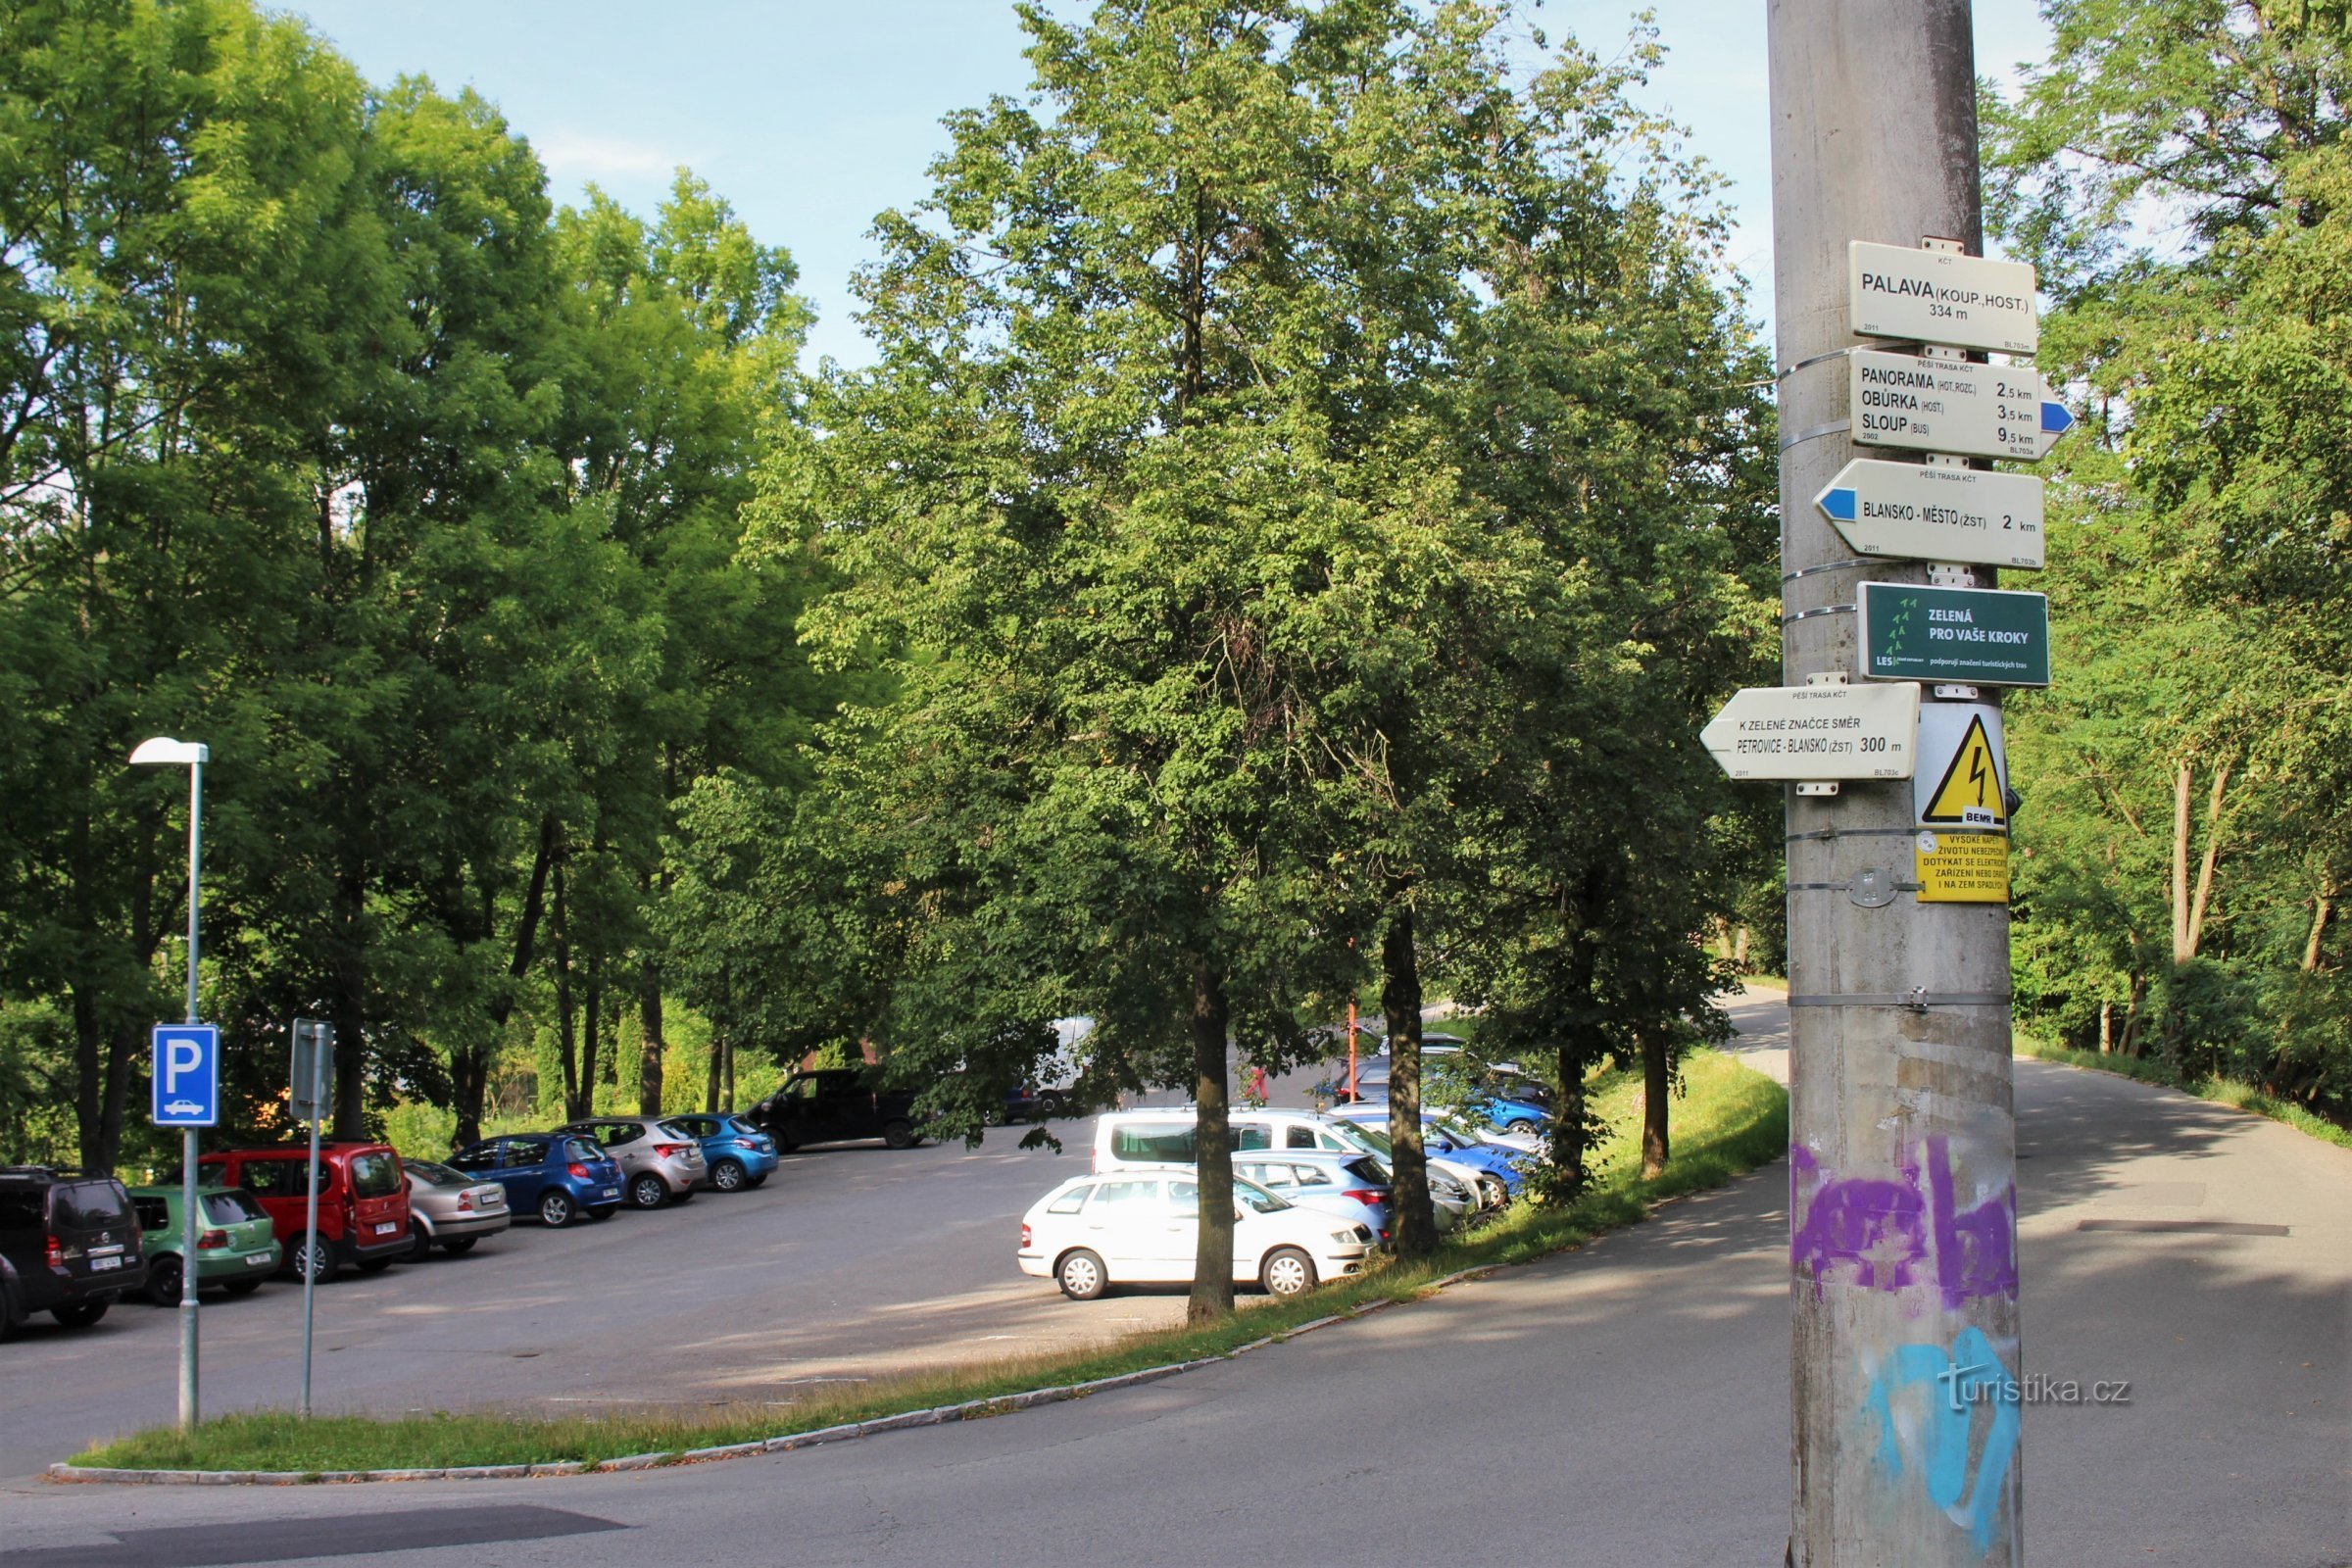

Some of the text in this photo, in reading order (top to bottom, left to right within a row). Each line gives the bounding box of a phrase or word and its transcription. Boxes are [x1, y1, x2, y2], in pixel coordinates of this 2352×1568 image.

[1862, 272, 1935, 299] PALAVA
[1929, 303, 1968, 320] 334 m
[1863, 323, 1879, 332] 2011
[1935, 362, 1958, 371] TRASA
[1959, 365, 1974, 373] KČT
[1862, 368, 1935, 390] PANORAMA
[1996, 382, 2015, 400] 2,5
[2017, 389, 2032, 400] km
[1862, 388, 2033, 422] OBŮRKA (HOST.) 3,5 km
[1862, 414, 2034, 445] SLOUP (BUS) 9,5 km
[1862, 432, 1879, 441] 2002
[1919, 470, 1977, 483] PĚŠÍ TRASA KČT
[1863, 501, 1914, 521] BLANSKO
[1922, 505, 1958, 525] MĚSTO
[1959, 514, 1987, 531] (ŽST)
[2002, 514, 2012, 530] 2
[2019, 520, 2036, 532] km
[1863, 544, 1880, 553] 2011
[1928, 608, 1974, 623] ZELENÁ
[1929, 627, 2029, 645] PRO VAŠE KROKY
[1930, 658, 1959, 667] podporují
[1959, 659, 1982, 667] značení
[1982, 660, 2015, 670] turistických
[1792, 690, 1846, 700] PĚŠÍ TRASA KČT
[1740, 715, 1861, 731] K ZELENÉ ZNAČCE SMĚR
[1737, 738, 1782, 754] PETROVICE
[1788, 737, 1827, 753] BLANSKO
[1829, 739, 1853, 755] (ŽST)
[1860, 737, 1886, 753] 300
[1891, 743, 1901, 752] m
[1966, 812, 1991, 824] BEMR
[1938, 846, 1969, 855] ŽIVOTU
[1923, 857, 1963, 866] DOTÝKAT
[1965, 858, 1975, 866] SE
[1936, 867, 1974, 878] ZAŘÍZENÍ
[1976, 869, 1991, 878] NEBO
[167, 1039, 203, 1094] P
